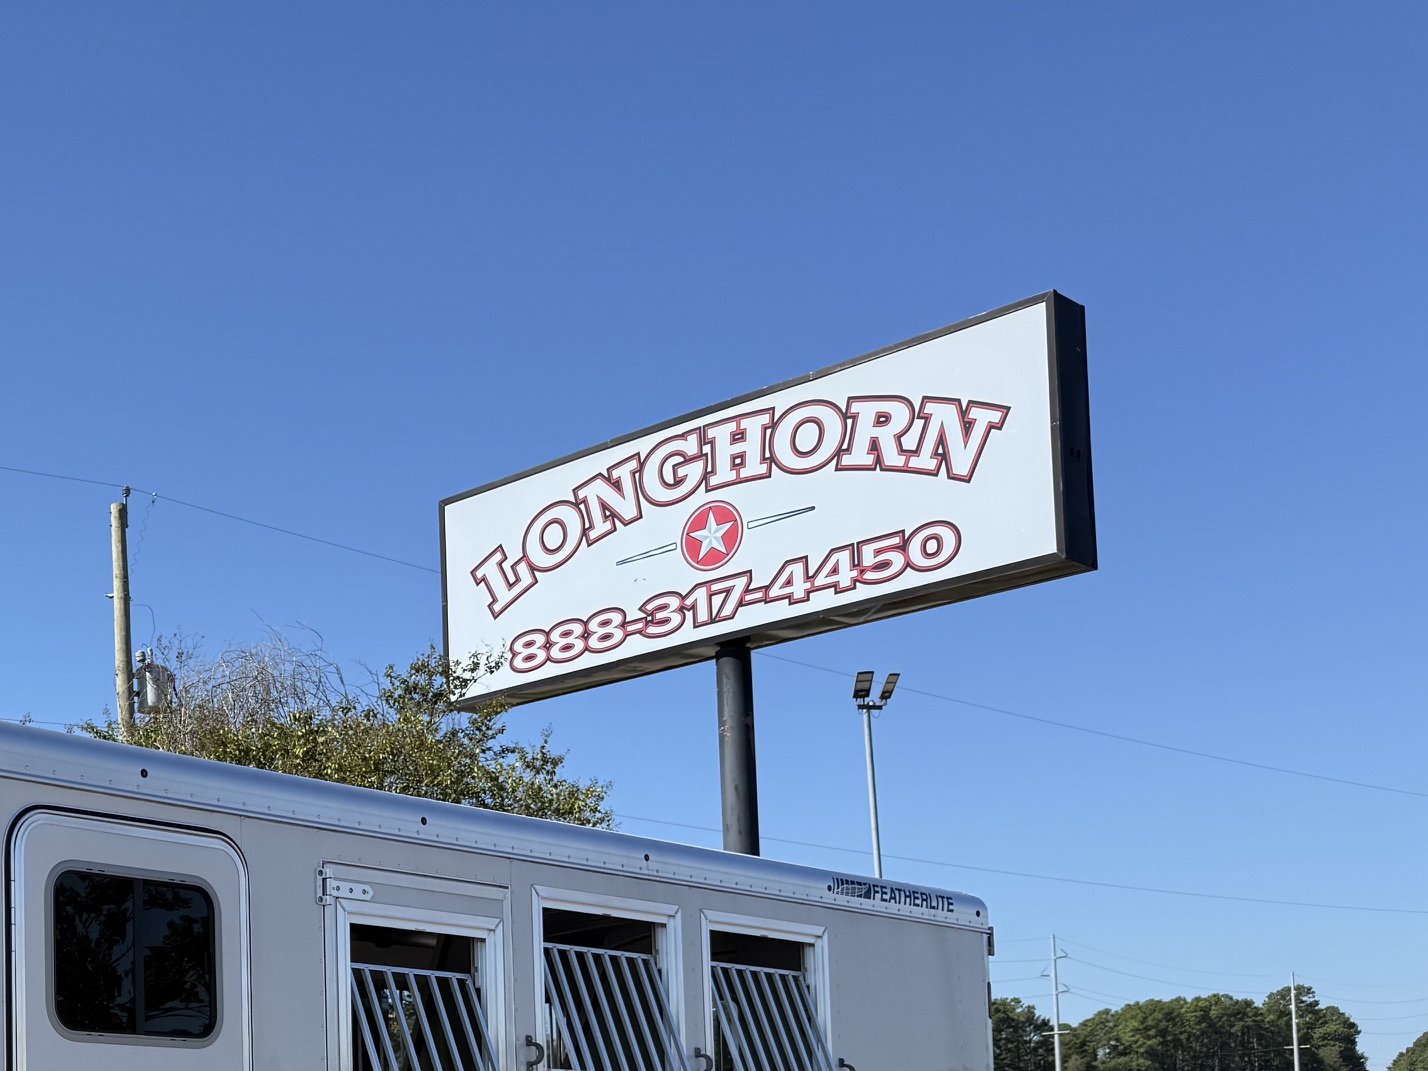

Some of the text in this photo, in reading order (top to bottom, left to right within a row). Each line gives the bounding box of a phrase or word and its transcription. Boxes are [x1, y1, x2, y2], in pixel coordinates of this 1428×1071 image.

[472, 395, 1010, 618] LONGHORN
[509, 519, 961, 673] 888-317-4450
[872, 883, 955, 913] FEATHERLITE
